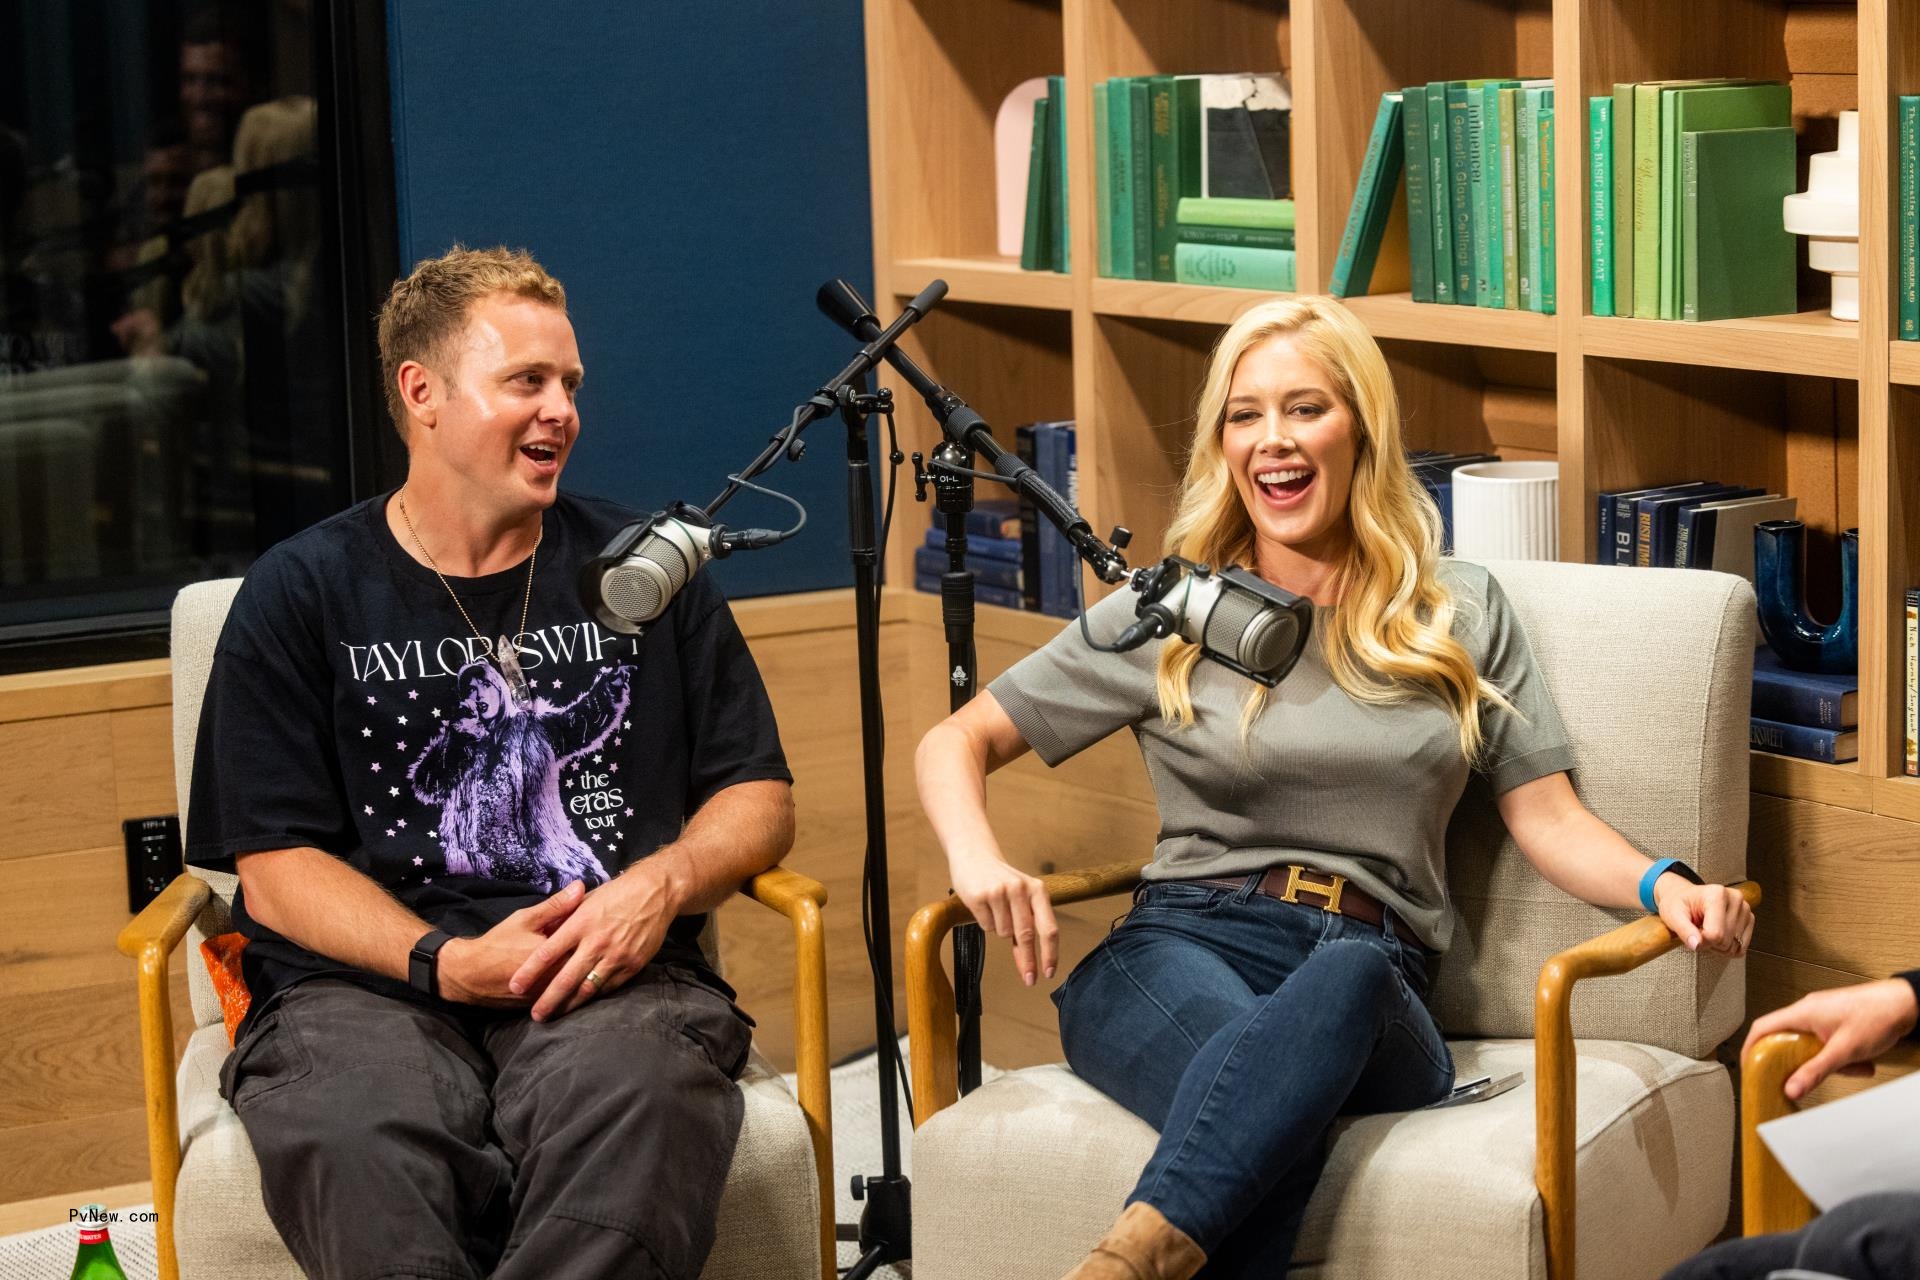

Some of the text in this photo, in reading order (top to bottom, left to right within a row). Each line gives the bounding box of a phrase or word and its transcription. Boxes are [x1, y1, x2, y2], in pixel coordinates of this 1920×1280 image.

[1908, 106, 1916, 124] The
[1467, 105, 1481, 183] Influencer
[1594, 128, 1603, 149] The
[1594, 153, 1603, 188] BASIC
[1454, 115, 1470, 266] Genetic Glass Ceilings
[1595, 239, 1604, 255] the
[1595, 258, 1605, 281] CAT
[1638, 512, 1651, 542] RUSH
[1909, 626, 1917, 648] Nick
[340, 621, 638, 683] TAYLOR SWIF
[580, 771, 610, 789] the
[569, 788, 624, 815] eras
[585, 814, 617, 830] tour
